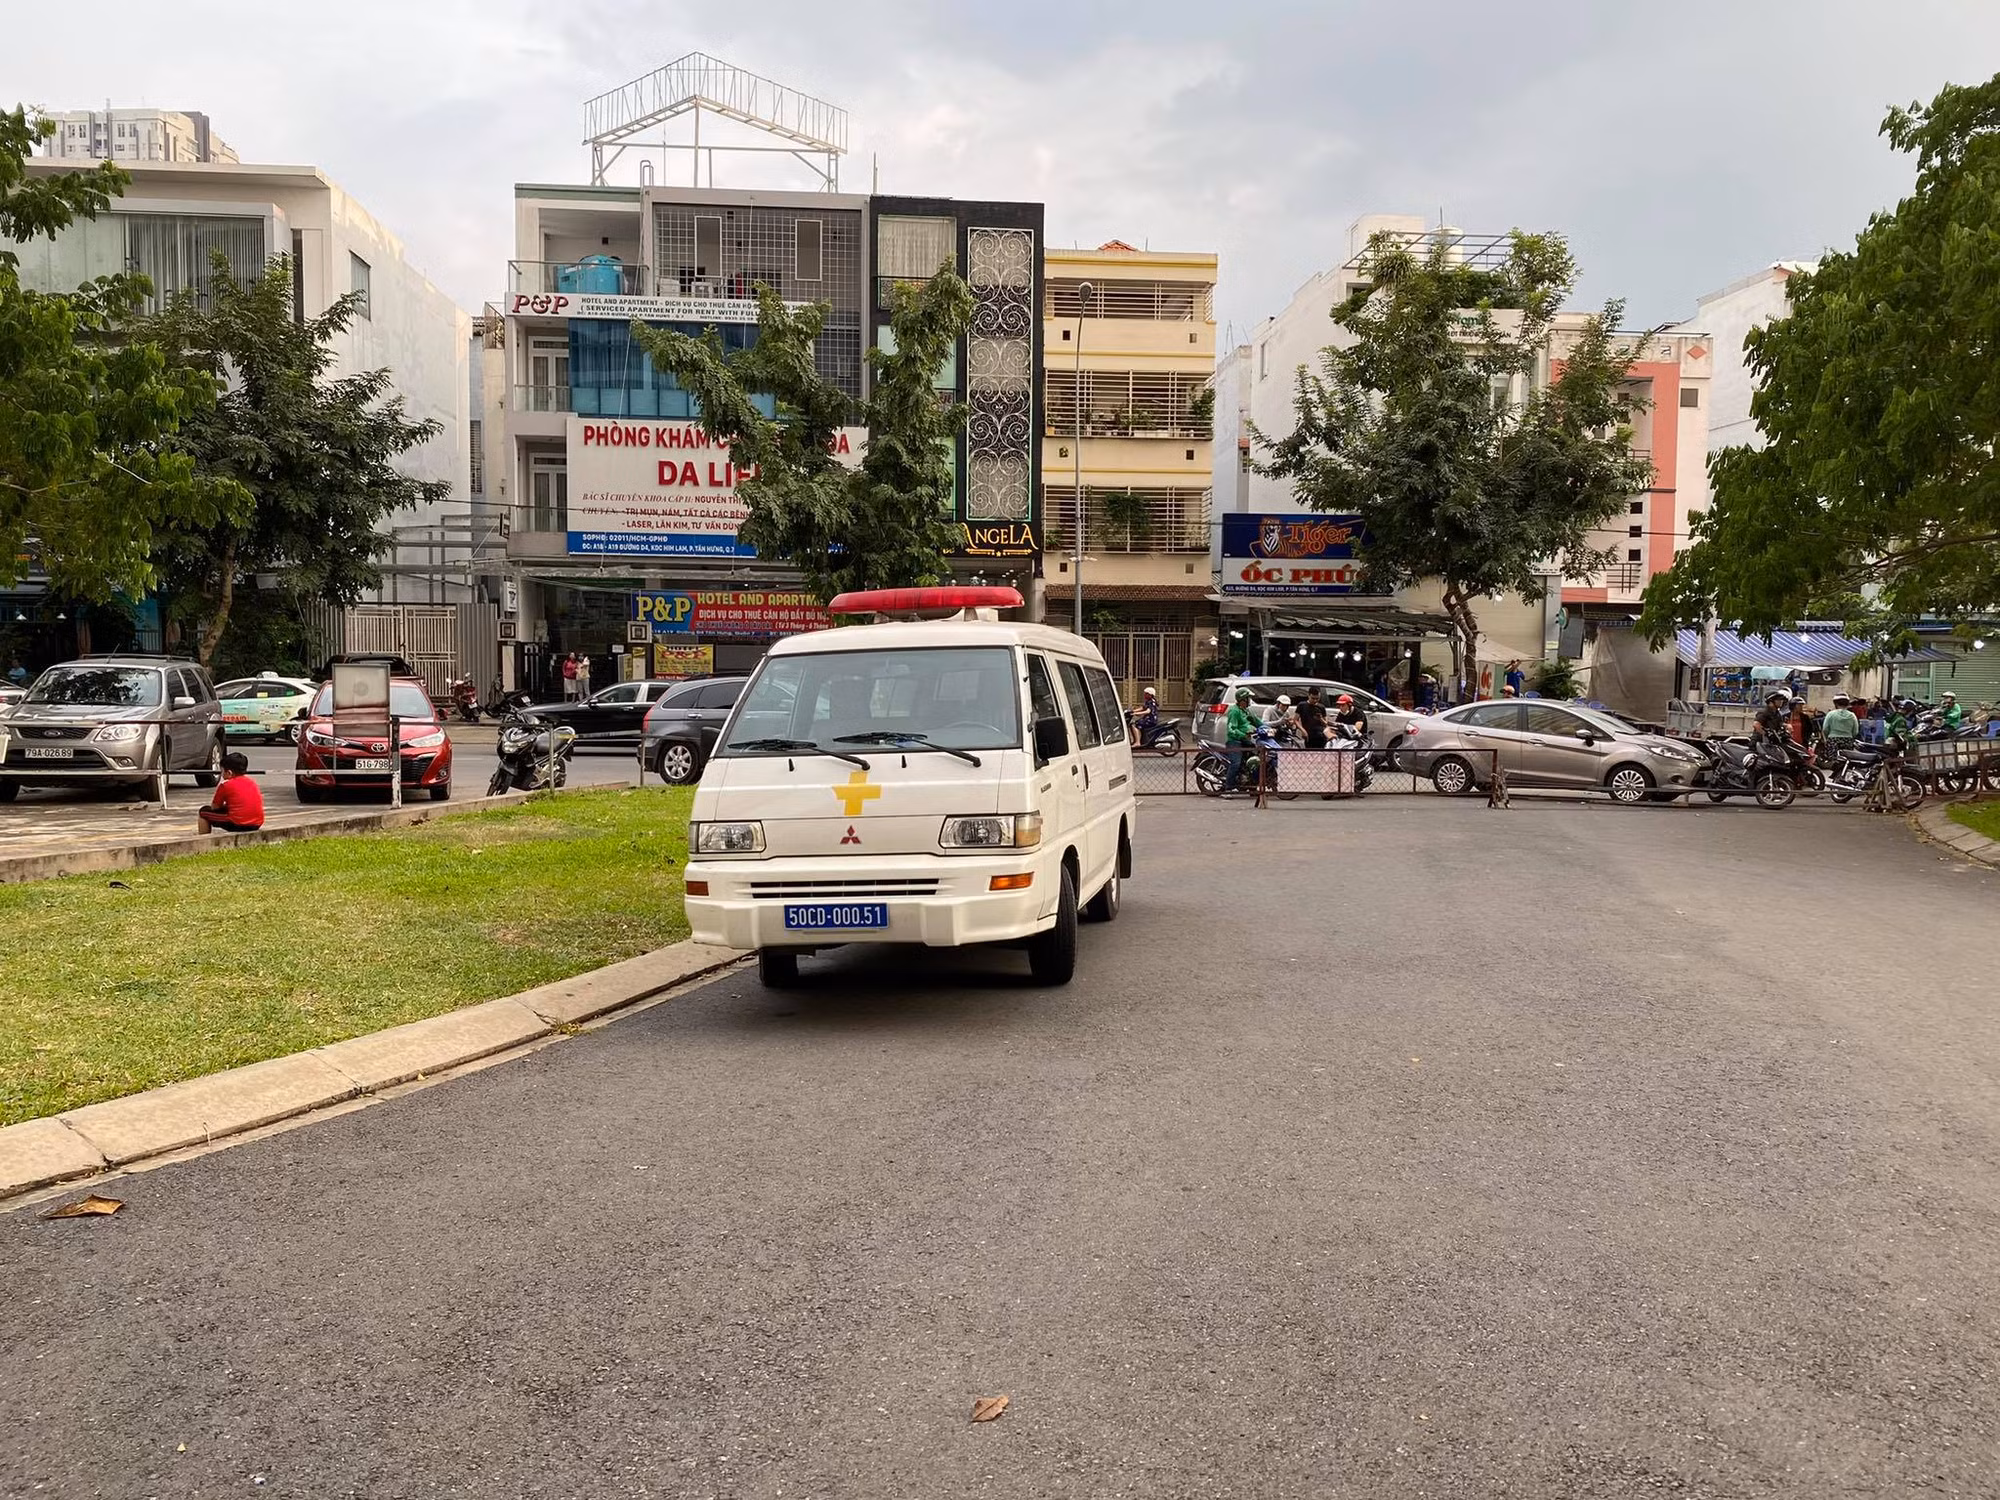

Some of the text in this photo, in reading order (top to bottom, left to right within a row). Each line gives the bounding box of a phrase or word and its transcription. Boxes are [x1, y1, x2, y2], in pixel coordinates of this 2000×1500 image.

[511, 294, 570, 315] P&P
[619, 298, 658, 306] APARTMENT
[627, 306, 675, 314] APARTMENT
[583, 420, 651, 447] PHÒNG
[655, 423, 711, 449] KHÁM
[658, 460, 700, 487] DA
[626, 520, 654, 529] LASER,
[673, 521, 690, 530] KIM,
[1288, 520, 1352, 553] Tiger
[1241, 560, 1283, 583] ỐC
[636, 596, 691, 622] P&P
[697, 592, 824, 606] HOTEL AND APARTM
[699, 609, 716, 621] DỊCH
[717, 609, 727, 621] VỤ
[728, 610, 743, 620] CHO
[744, 609, 762, 620] THUÊ
[357, 759, 389, 768] 51G-798
[789, 906, 881, 926] 50CD-000.51
